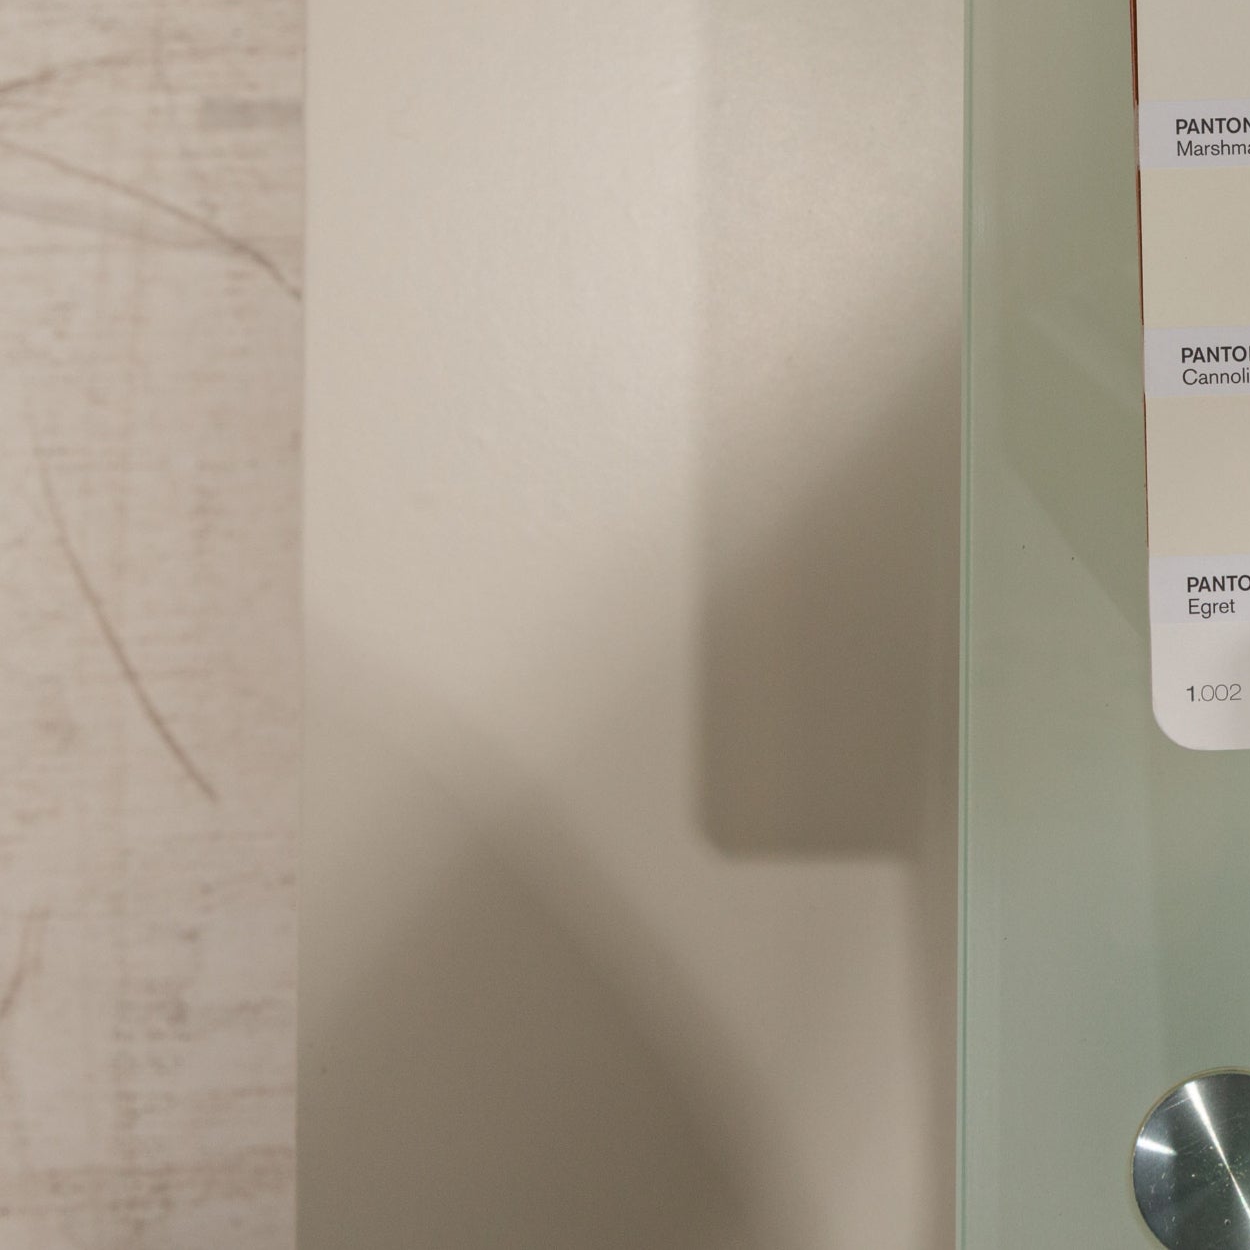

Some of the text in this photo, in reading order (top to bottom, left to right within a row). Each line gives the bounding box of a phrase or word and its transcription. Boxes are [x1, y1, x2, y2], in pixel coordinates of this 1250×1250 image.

[1182, 367, 1250, 386] Cannoli
[1188, 597, 1236, 620] Egret
[1185, 683, 1243, 703] 1.002
